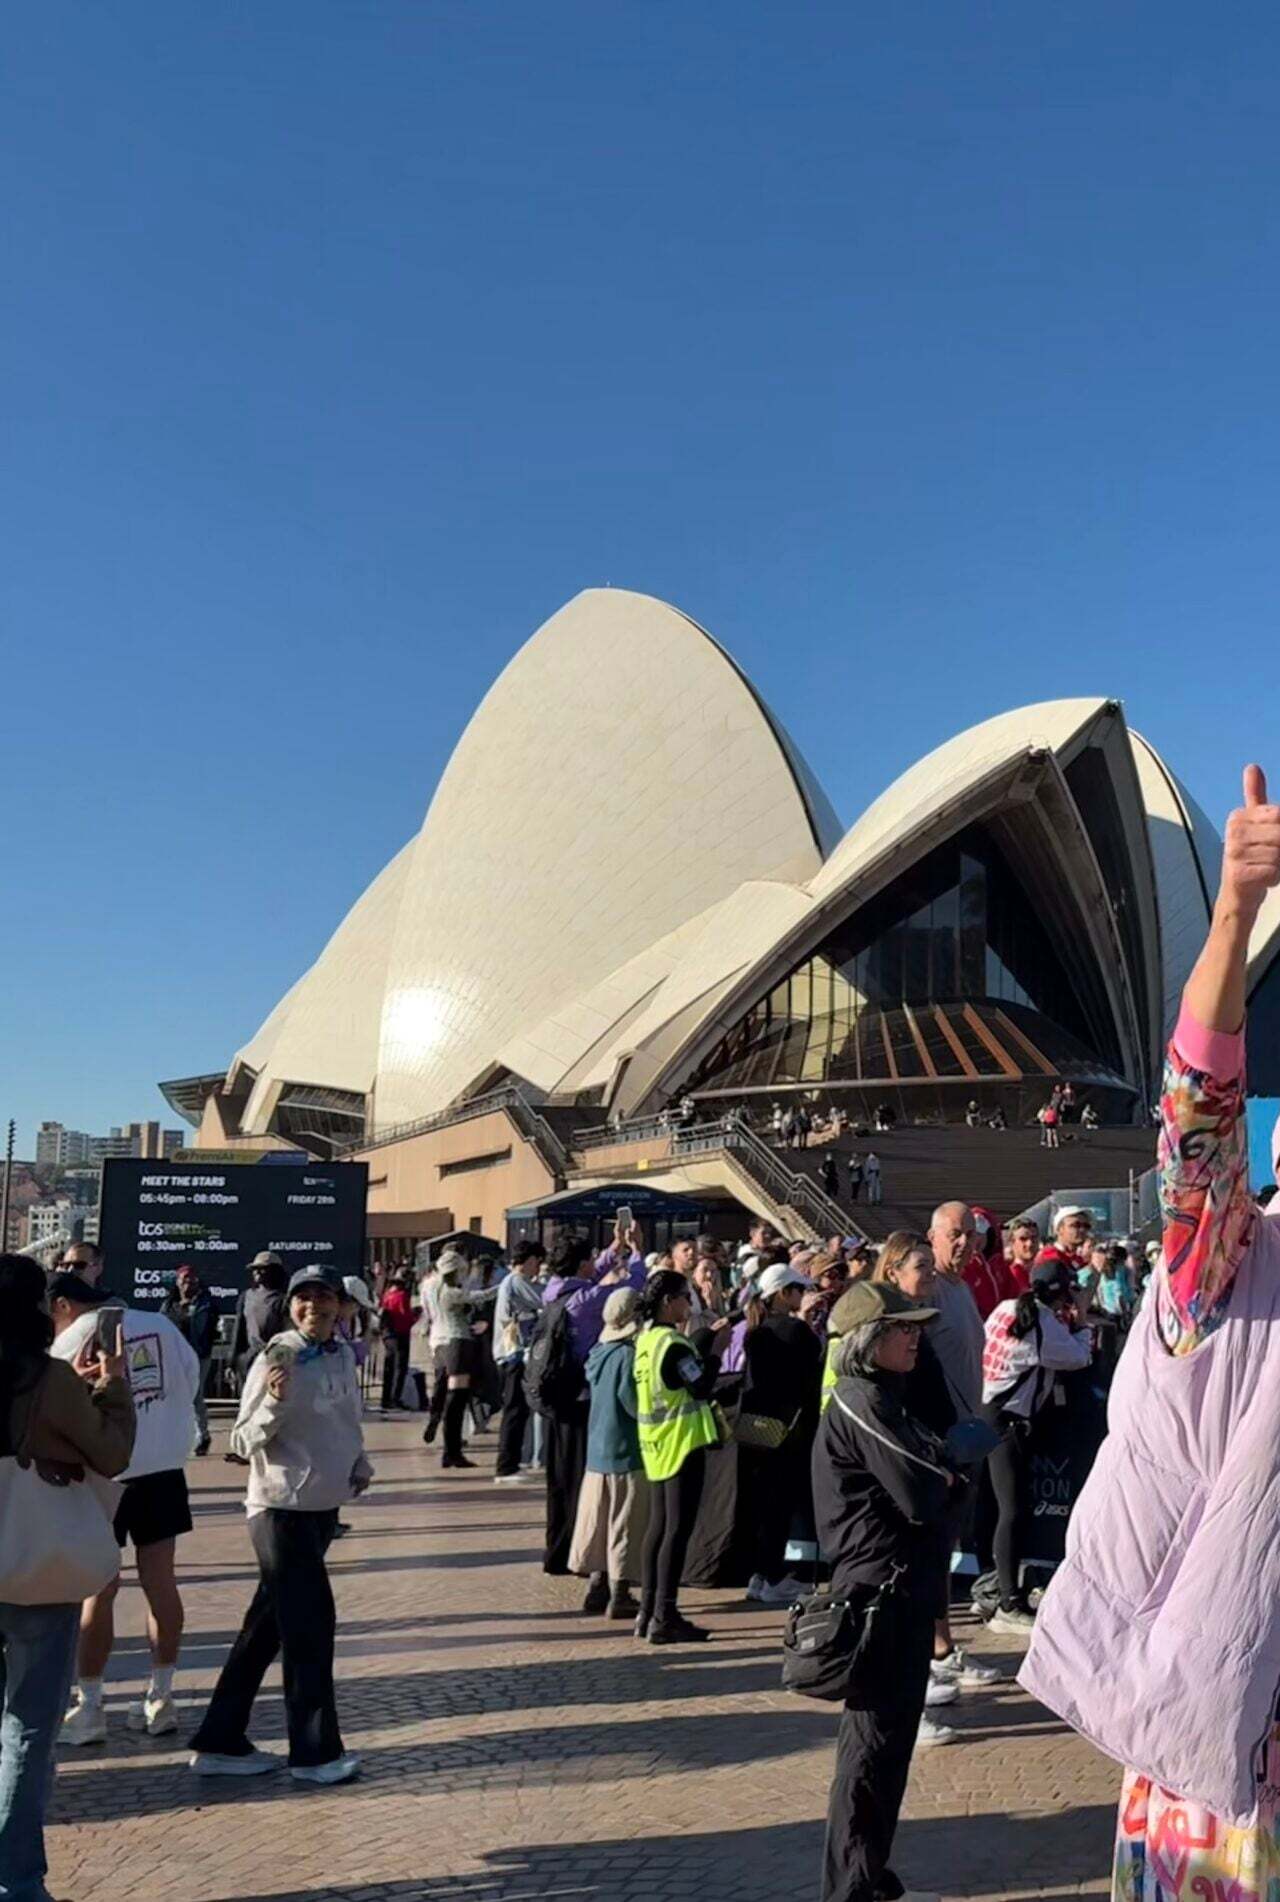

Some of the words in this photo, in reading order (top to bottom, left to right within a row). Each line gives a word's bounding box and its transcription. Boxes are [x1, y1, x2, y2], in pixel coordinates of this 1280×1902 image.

[141, 1176, 169, 1186] MEET
[171, 1176, 191, 1186] THE
[192, 1176, 225, 1187] STARS
[287, 1195, 316, 1204] FRIDAY
[139, 1220, 163, 1236] tcs
[268, 1241, 312, 1251] SATURDAY
[135, 1267, 160, 1284] tcs
